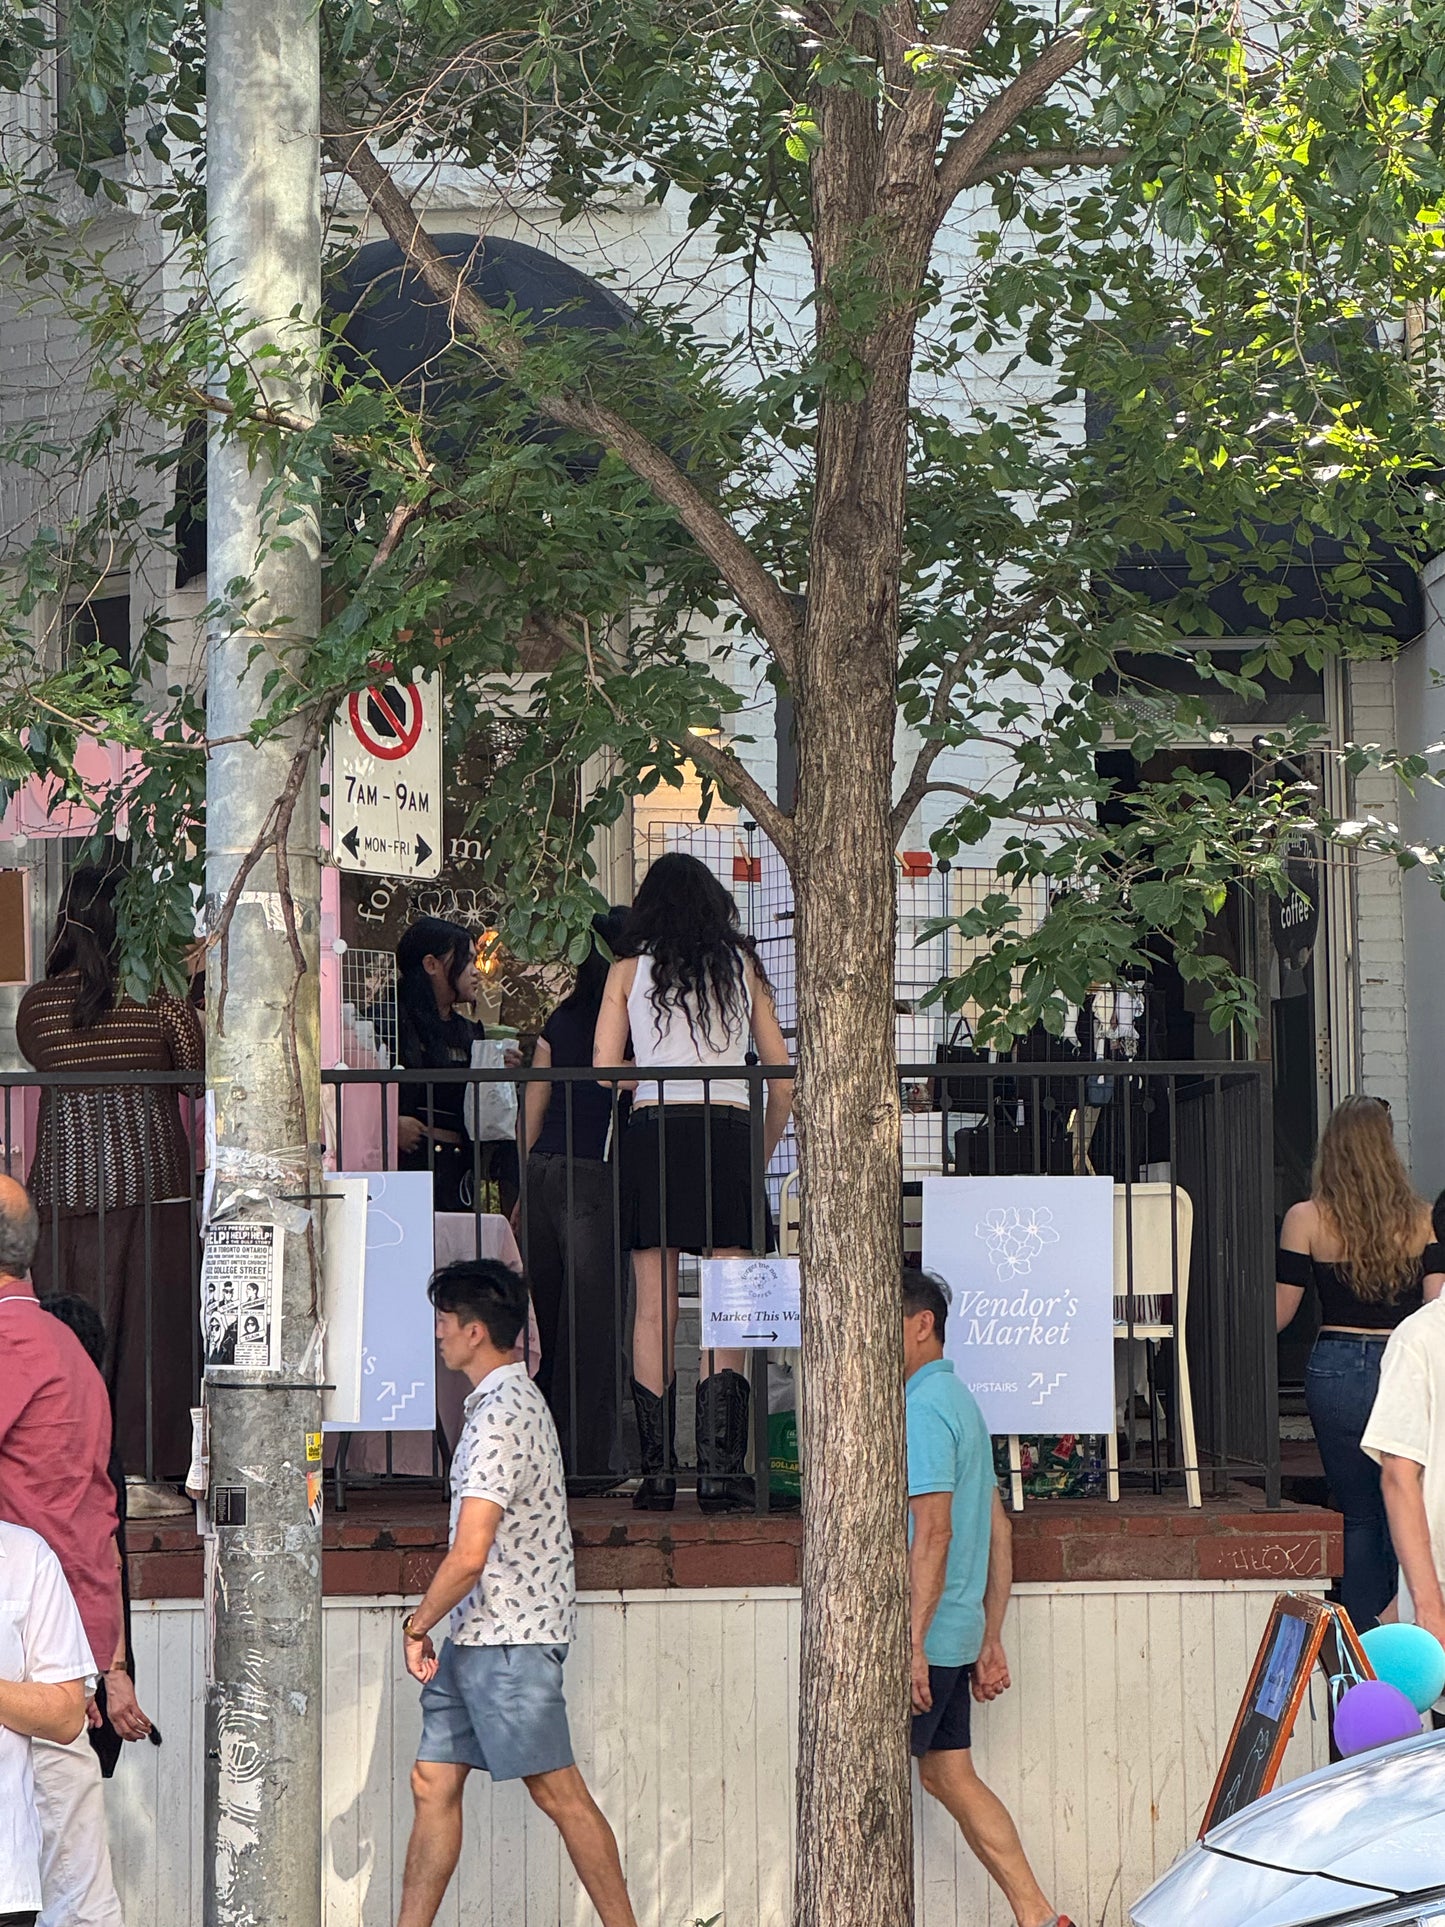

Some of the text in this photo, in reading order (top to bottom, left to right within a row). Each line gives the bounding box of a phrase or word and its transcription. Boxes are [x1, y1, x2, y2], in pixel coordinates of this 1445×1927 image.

[345, 775, 377, 807] 7AM
[396, 783, 429, 813] 9AM
[364, 836, 410, 856] MON-FRI
[358, 876, 415, 924] for
[1280, 891, 1309, 929] coffee
[251, 1232, 272, 1240] HELP!
[214, 1266, 238, 1274] COLLEGE
[958, 1288, 1079, 1318] Vendor's
[710, 1310, 800, 1322] Market This Wa
[245, 1333, 260, 1341] SLAIN
[963, 1318, 1071, 1345] Market
[968, 1382, 1018, 1392] UPSTAIRS
